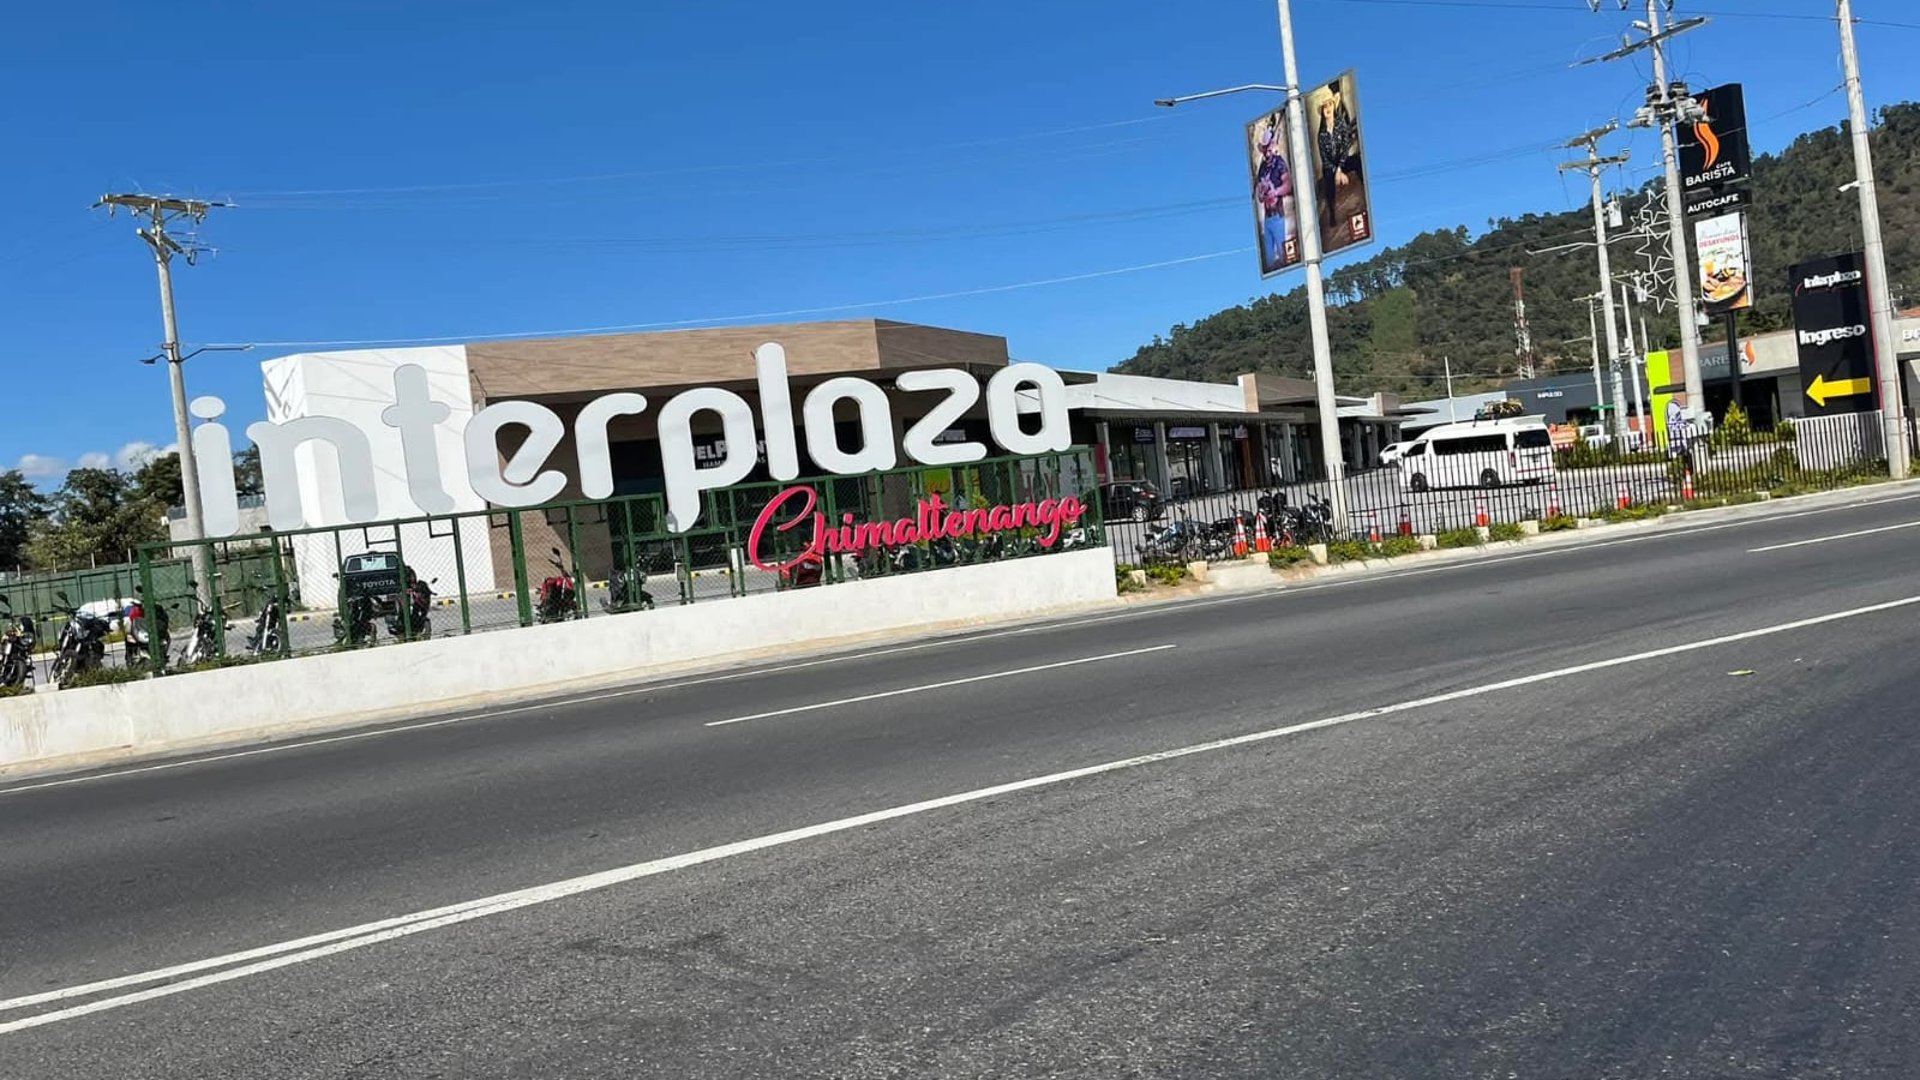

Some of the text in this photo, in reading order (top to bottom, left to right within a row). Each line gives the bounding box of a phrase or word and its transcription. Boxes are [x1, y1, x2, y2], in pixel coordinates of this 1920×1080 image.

[1685, 166, 1736, 186] BARISTA
[1687, 193, 1739, 213] AUTOCAFE
[1799, 324, 1866, 346] Ingreso
[192, 342, 1073, 538] interplaza
[748, 485, 1087, 573] Chimaltenango
[362, 579, 396, 589] TOYOTA
